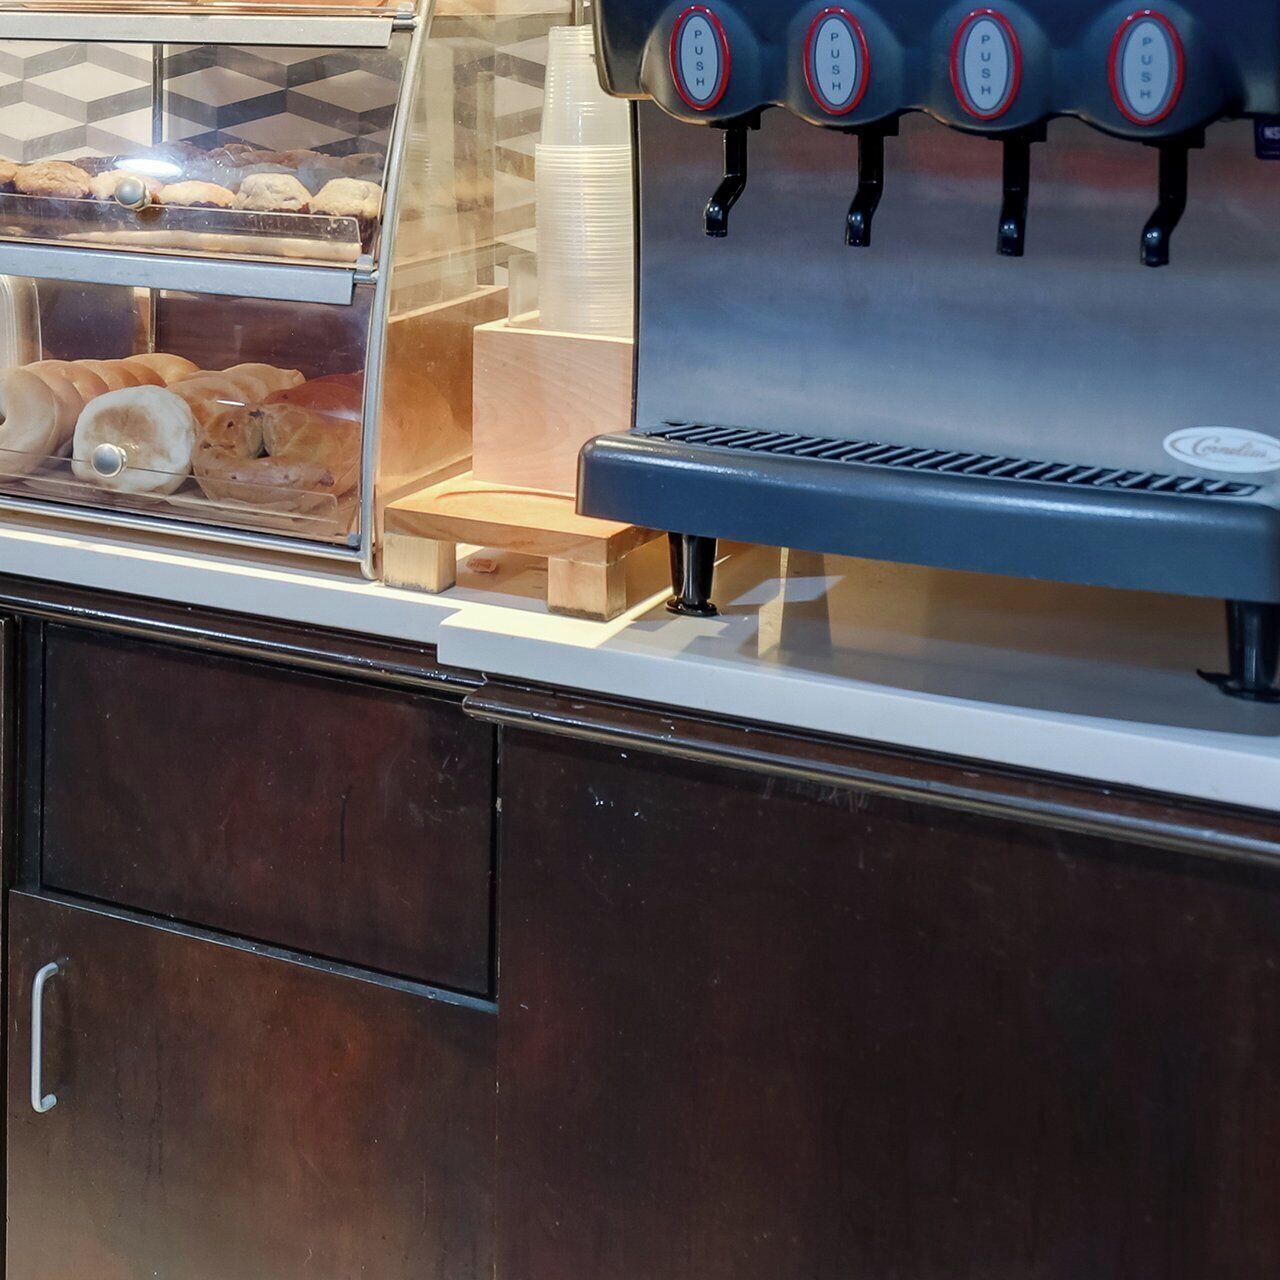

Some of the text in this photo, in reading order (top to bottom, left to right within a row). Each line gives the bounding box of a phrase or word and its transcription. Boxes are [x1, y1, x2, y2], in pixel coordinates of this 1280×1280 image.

[694, 30, 705, 87] PUSH
[829, 32, 841, 91] PUSH
[980, 35, 991, 95] PUSH
[1140, 36, 1153, 99] PUSH
